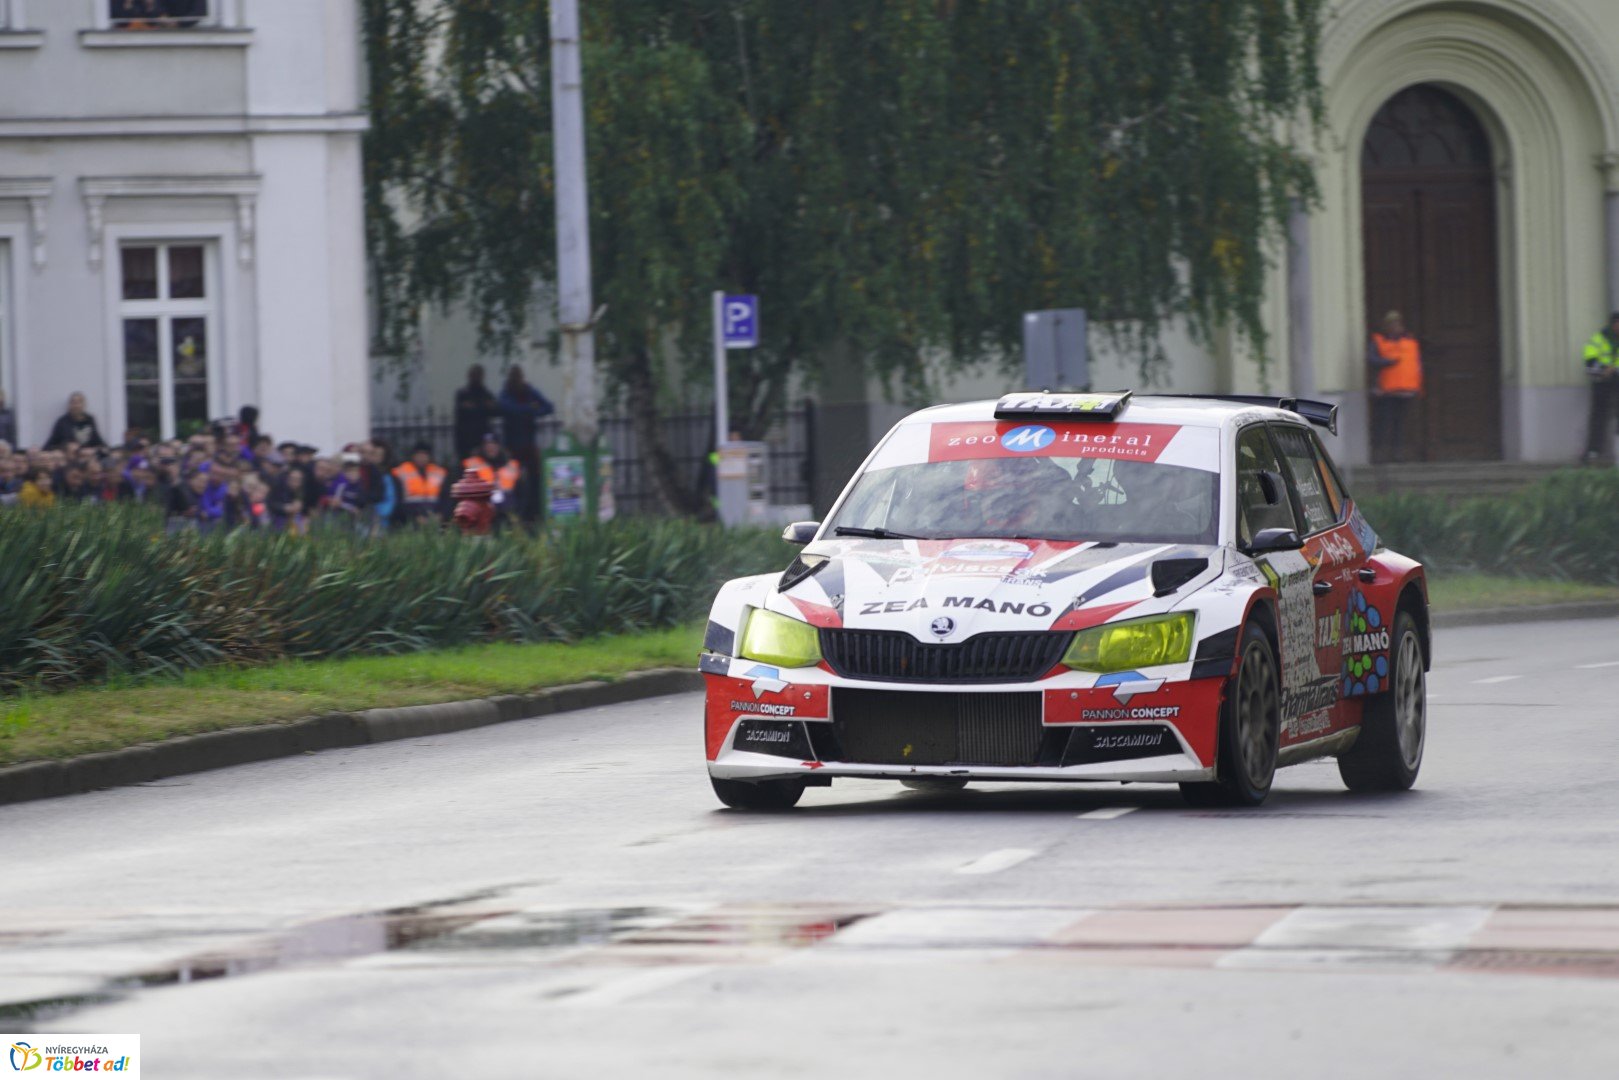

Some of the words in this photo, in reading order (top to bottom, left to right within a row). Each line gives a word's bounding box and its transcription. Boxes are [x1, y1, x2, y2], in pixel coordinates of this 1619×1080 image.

[1081, 445, 1148, 456] products
[859, 597, 928, 616] ZEA
[942, 596, 1052, 617] MANÓ
[1353, 627, 1389, 653] MANÓ
[730, 700, 760, 713] PANNON
[760, 703, 796, 716] CONCEPT
[1082, 708, 1129, 720] PANNON
[1130, 706, 1180, 718] CONCEPT
